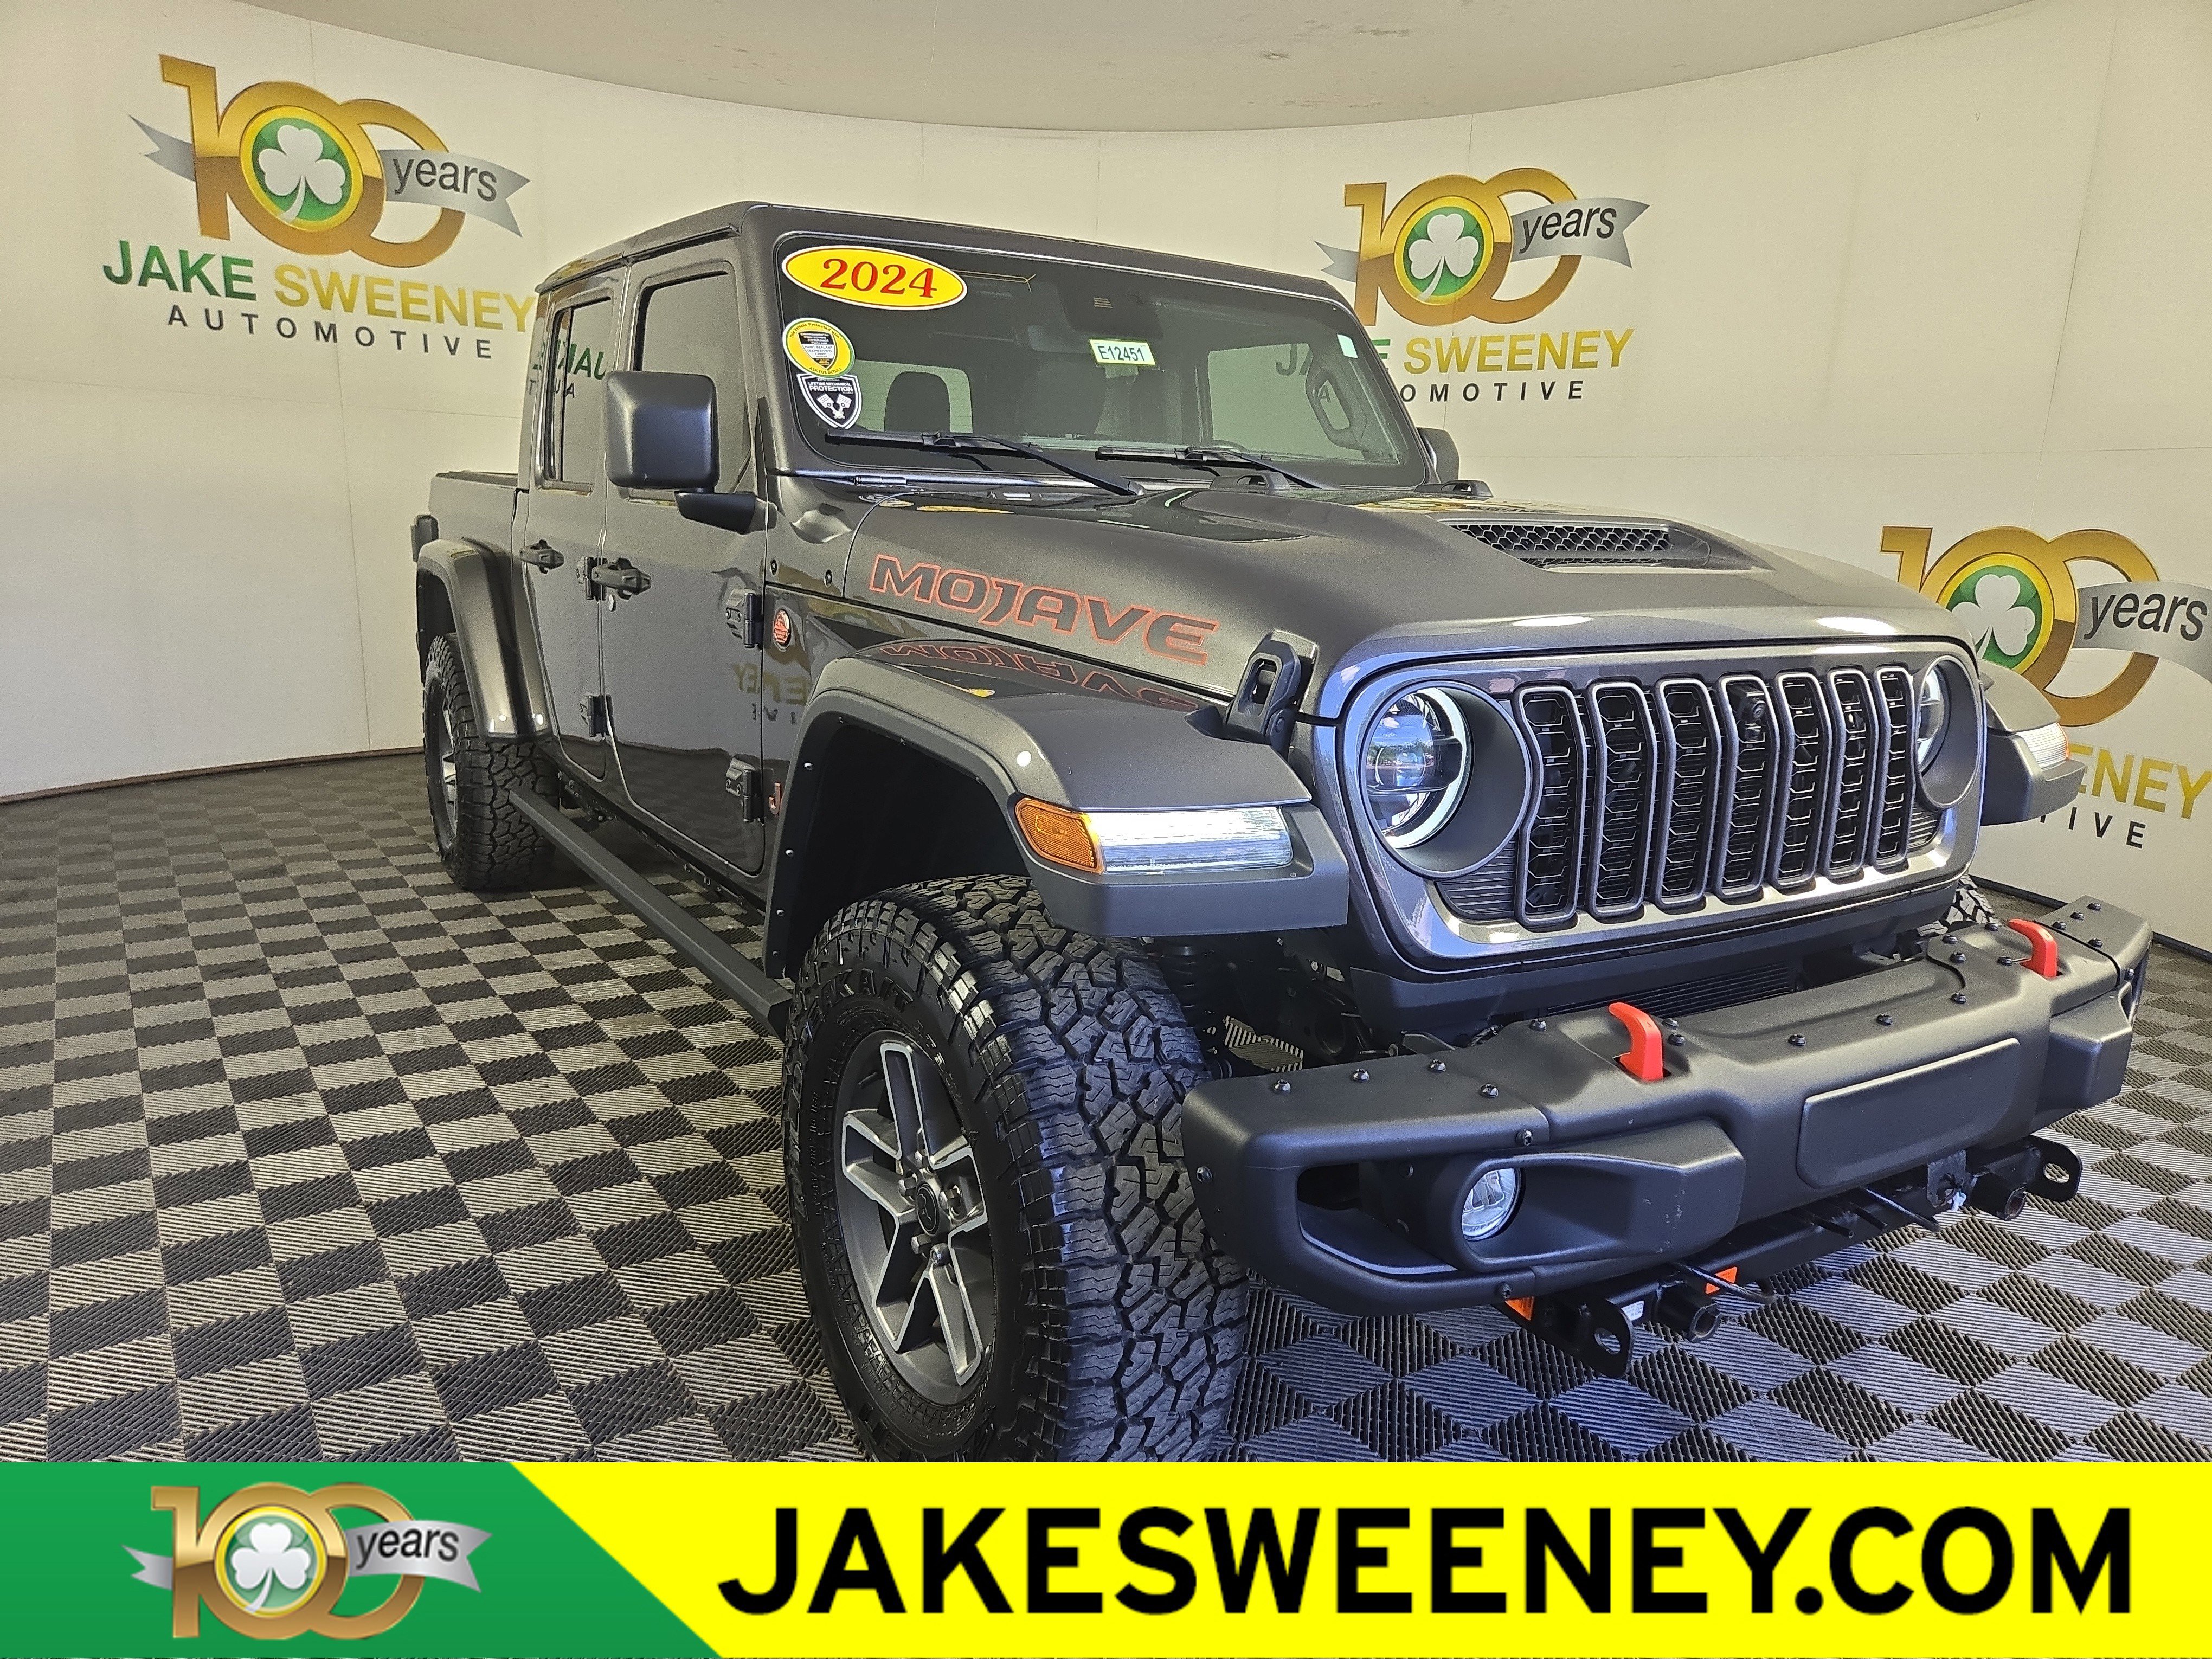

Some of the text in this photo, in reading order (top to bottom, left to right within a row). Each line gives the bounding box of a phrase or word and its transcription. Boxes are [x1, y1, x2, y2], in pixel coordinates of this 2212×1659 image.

[159, 53, 498, 268] 100 years
[1345, 167, 1617, 327] 100 years
[102, 239, 537, 333] JAKE SWEENEY
[820, 258, 938, 298] 2024
[167, 305, 492, 359] AUTOMOTIVE
[1097, 345, 1144, 362] E12451
[1404, 328, 1635, 375] SWEENEY
[870, 554, 1219, 666] MOJAVE
[2083, 593, 2208, 641] years
